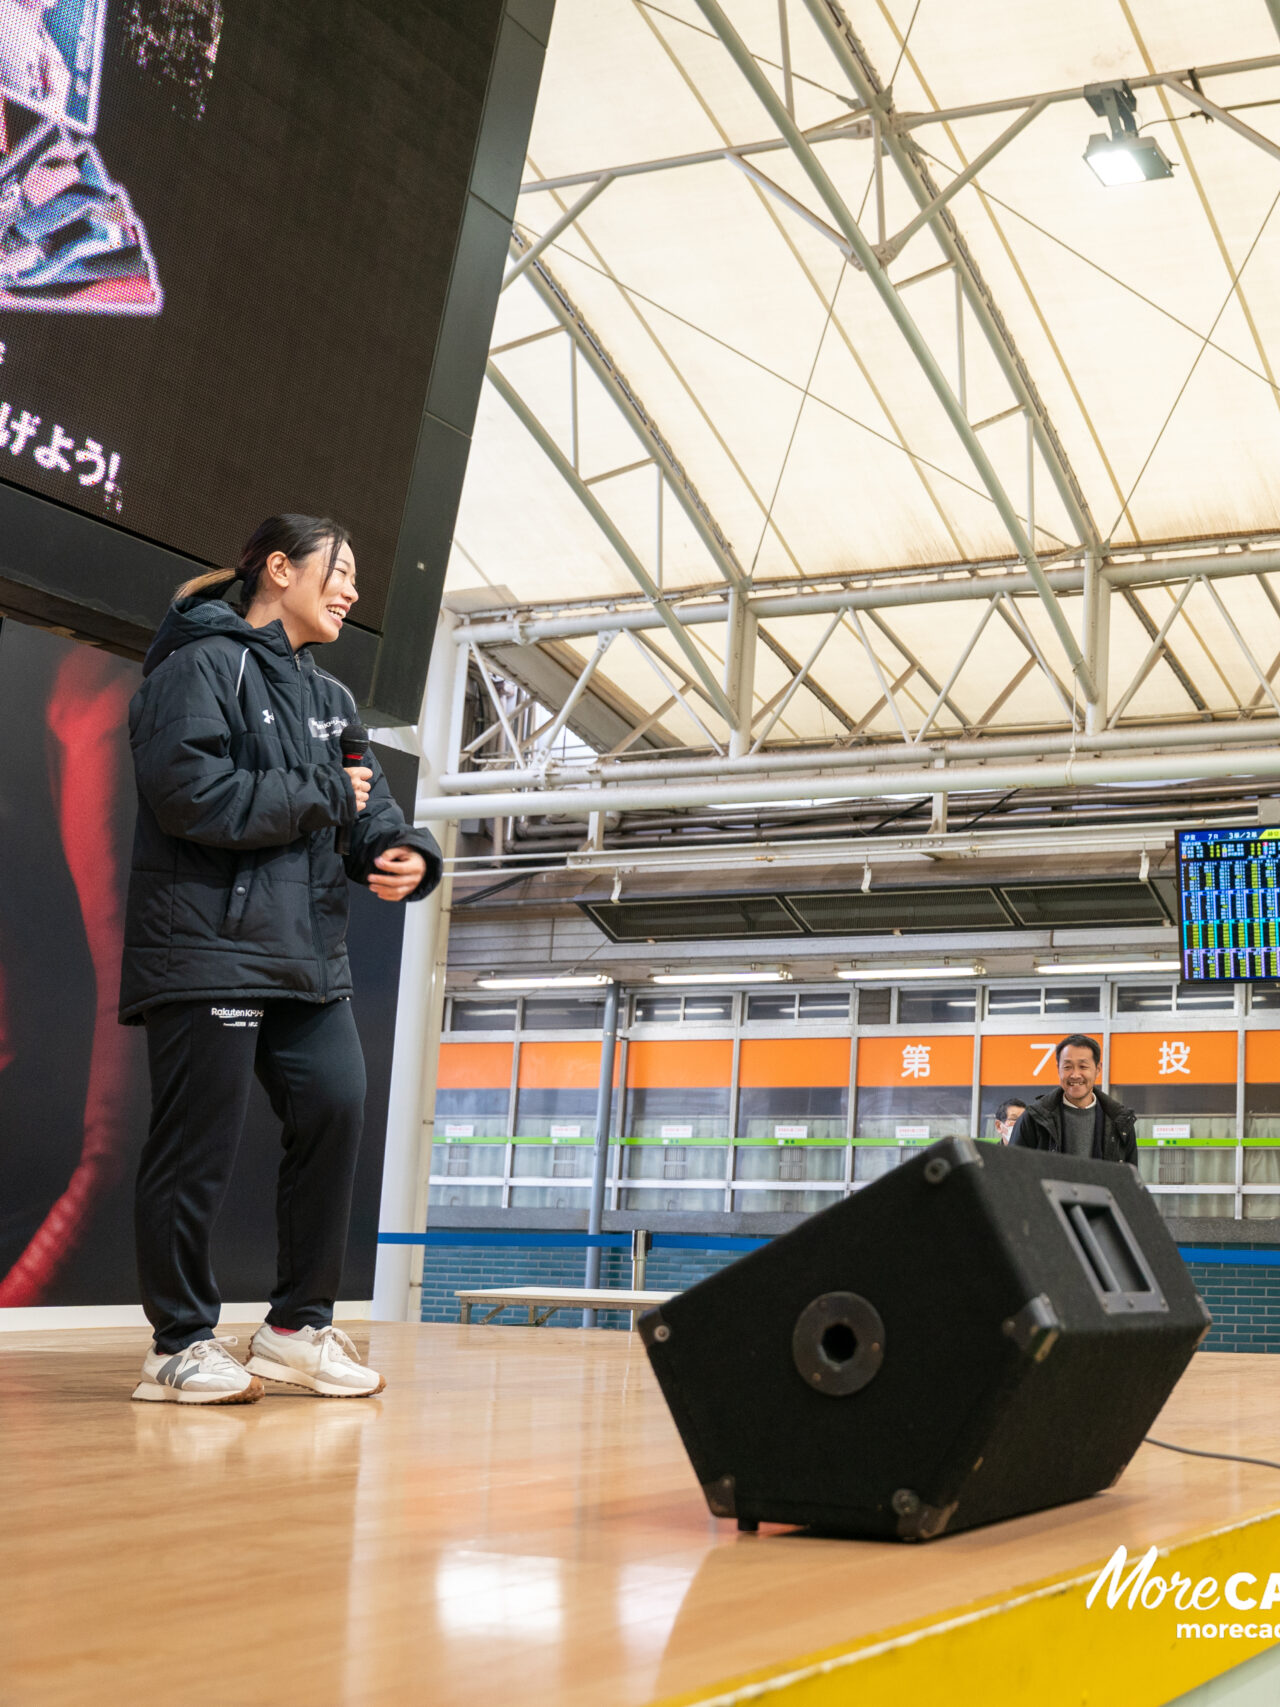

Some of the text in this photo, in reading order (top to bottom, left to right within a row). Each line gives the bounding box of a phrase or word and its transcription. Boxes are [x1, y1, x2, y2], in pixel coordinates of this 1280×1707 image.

[211, 1007, 245, 1018] Rakuten
[901, 1044, 931, 1079] 第
[1158, 1041, 1191, 1075] 投
